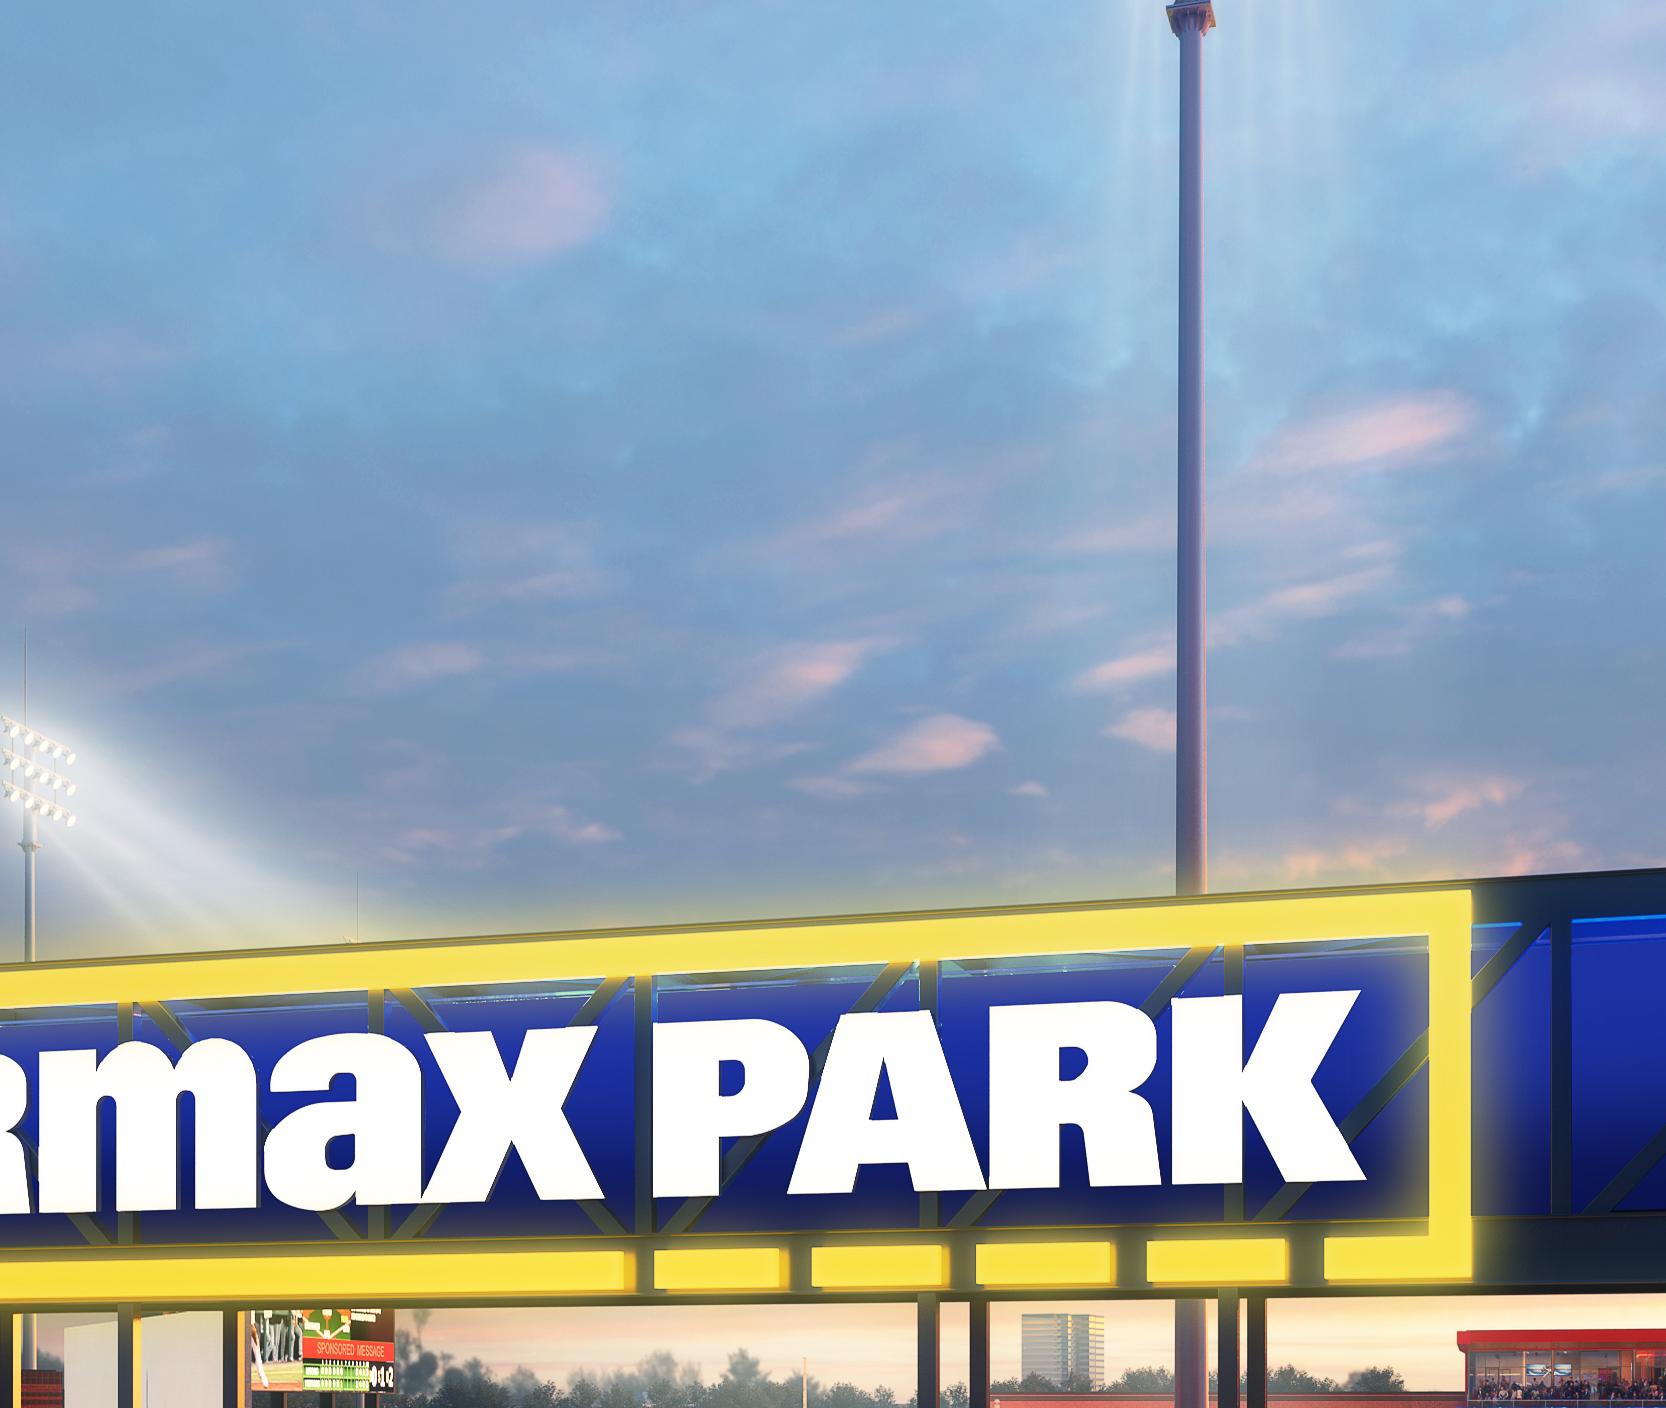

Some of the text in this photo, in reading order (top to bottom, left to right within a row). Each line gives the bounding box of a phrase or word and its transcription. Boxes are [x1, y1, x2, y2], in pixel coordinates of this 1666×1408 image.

[653, 990, 1367, 1198] PARK
[317, 1342, 385, 1358] SPONSORED MESSAGE
